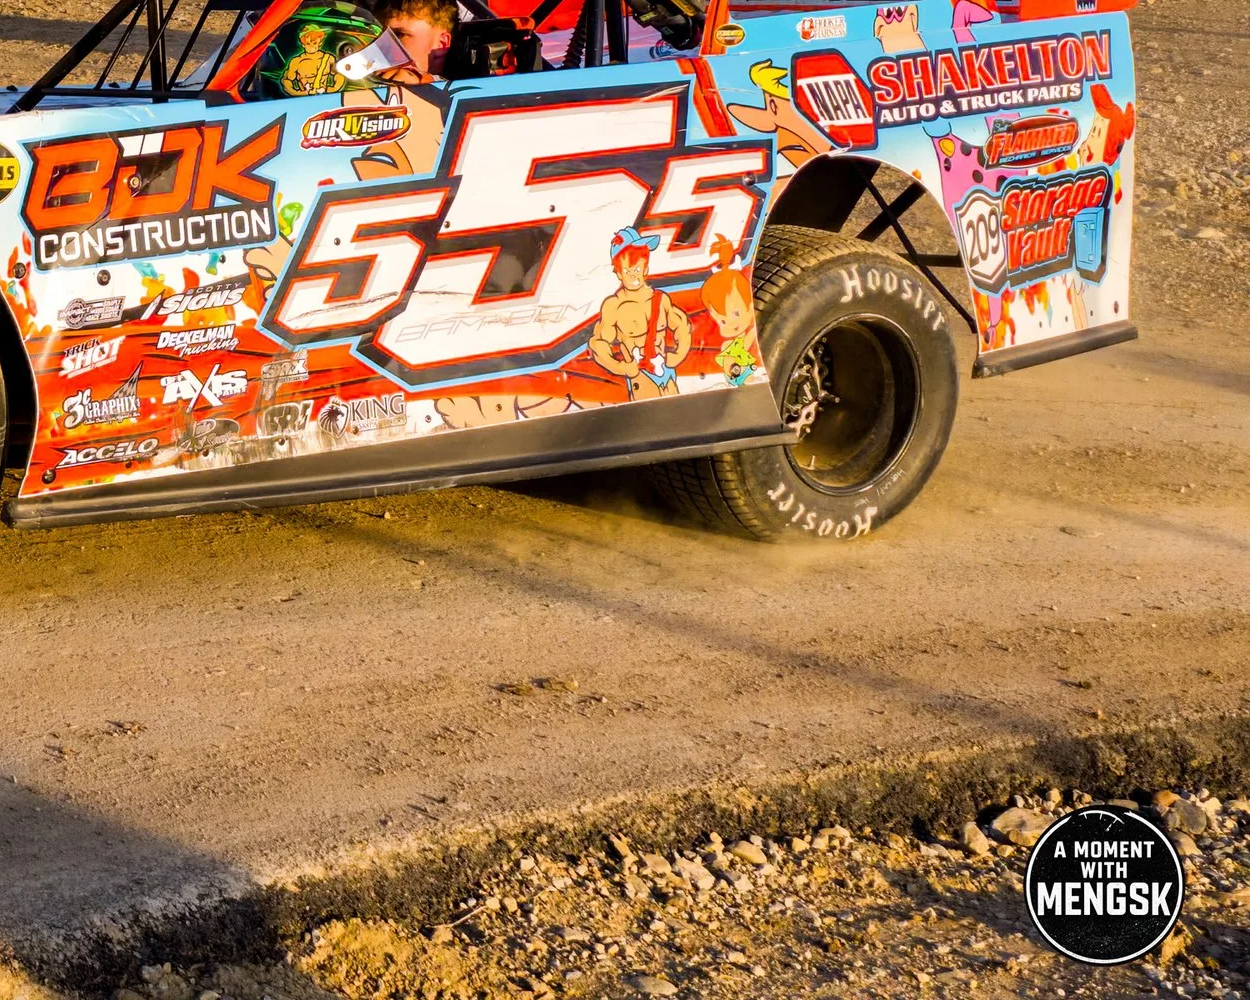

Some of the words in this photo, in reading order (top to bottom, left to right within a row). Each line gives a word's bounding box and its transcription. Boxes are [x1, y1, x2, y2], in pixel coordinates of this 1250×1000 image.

[869, 32, 1111, 105] SHAKELTON
[807, 78, 869, 126] NAPA
[880, 102, 937, 124] AUTO
[939, 100, 958, 114] &
[959, 91, 1025, 112] TRUCK
[1027, 82, 1082, 101] PARTS
[1001, 175, 1107, 231] Storage
[40, 207, 271, 264] CONSTRUCTION
[272, 94, 768, 368] 555
[965, 207, 1000, 268] 209
[1006, 217, 1072, 270] Vault
[157, 287, 246, 315] SIGNS
[187, 282, 242, 295] SCOTTY
[58, 335, 126, 376] SHOT
[64, 337, 102, 357] TRICK
[157, 324, 235, 349] DECKELMAN
[174, 338, 240, 358] Trucking
[85, 395, 138, 419] GRAPHIX
[162, 363, 248, 414] AXIS
[351, 394, 405, 422] KING
[58, 438, 159, 466] ACCELO
